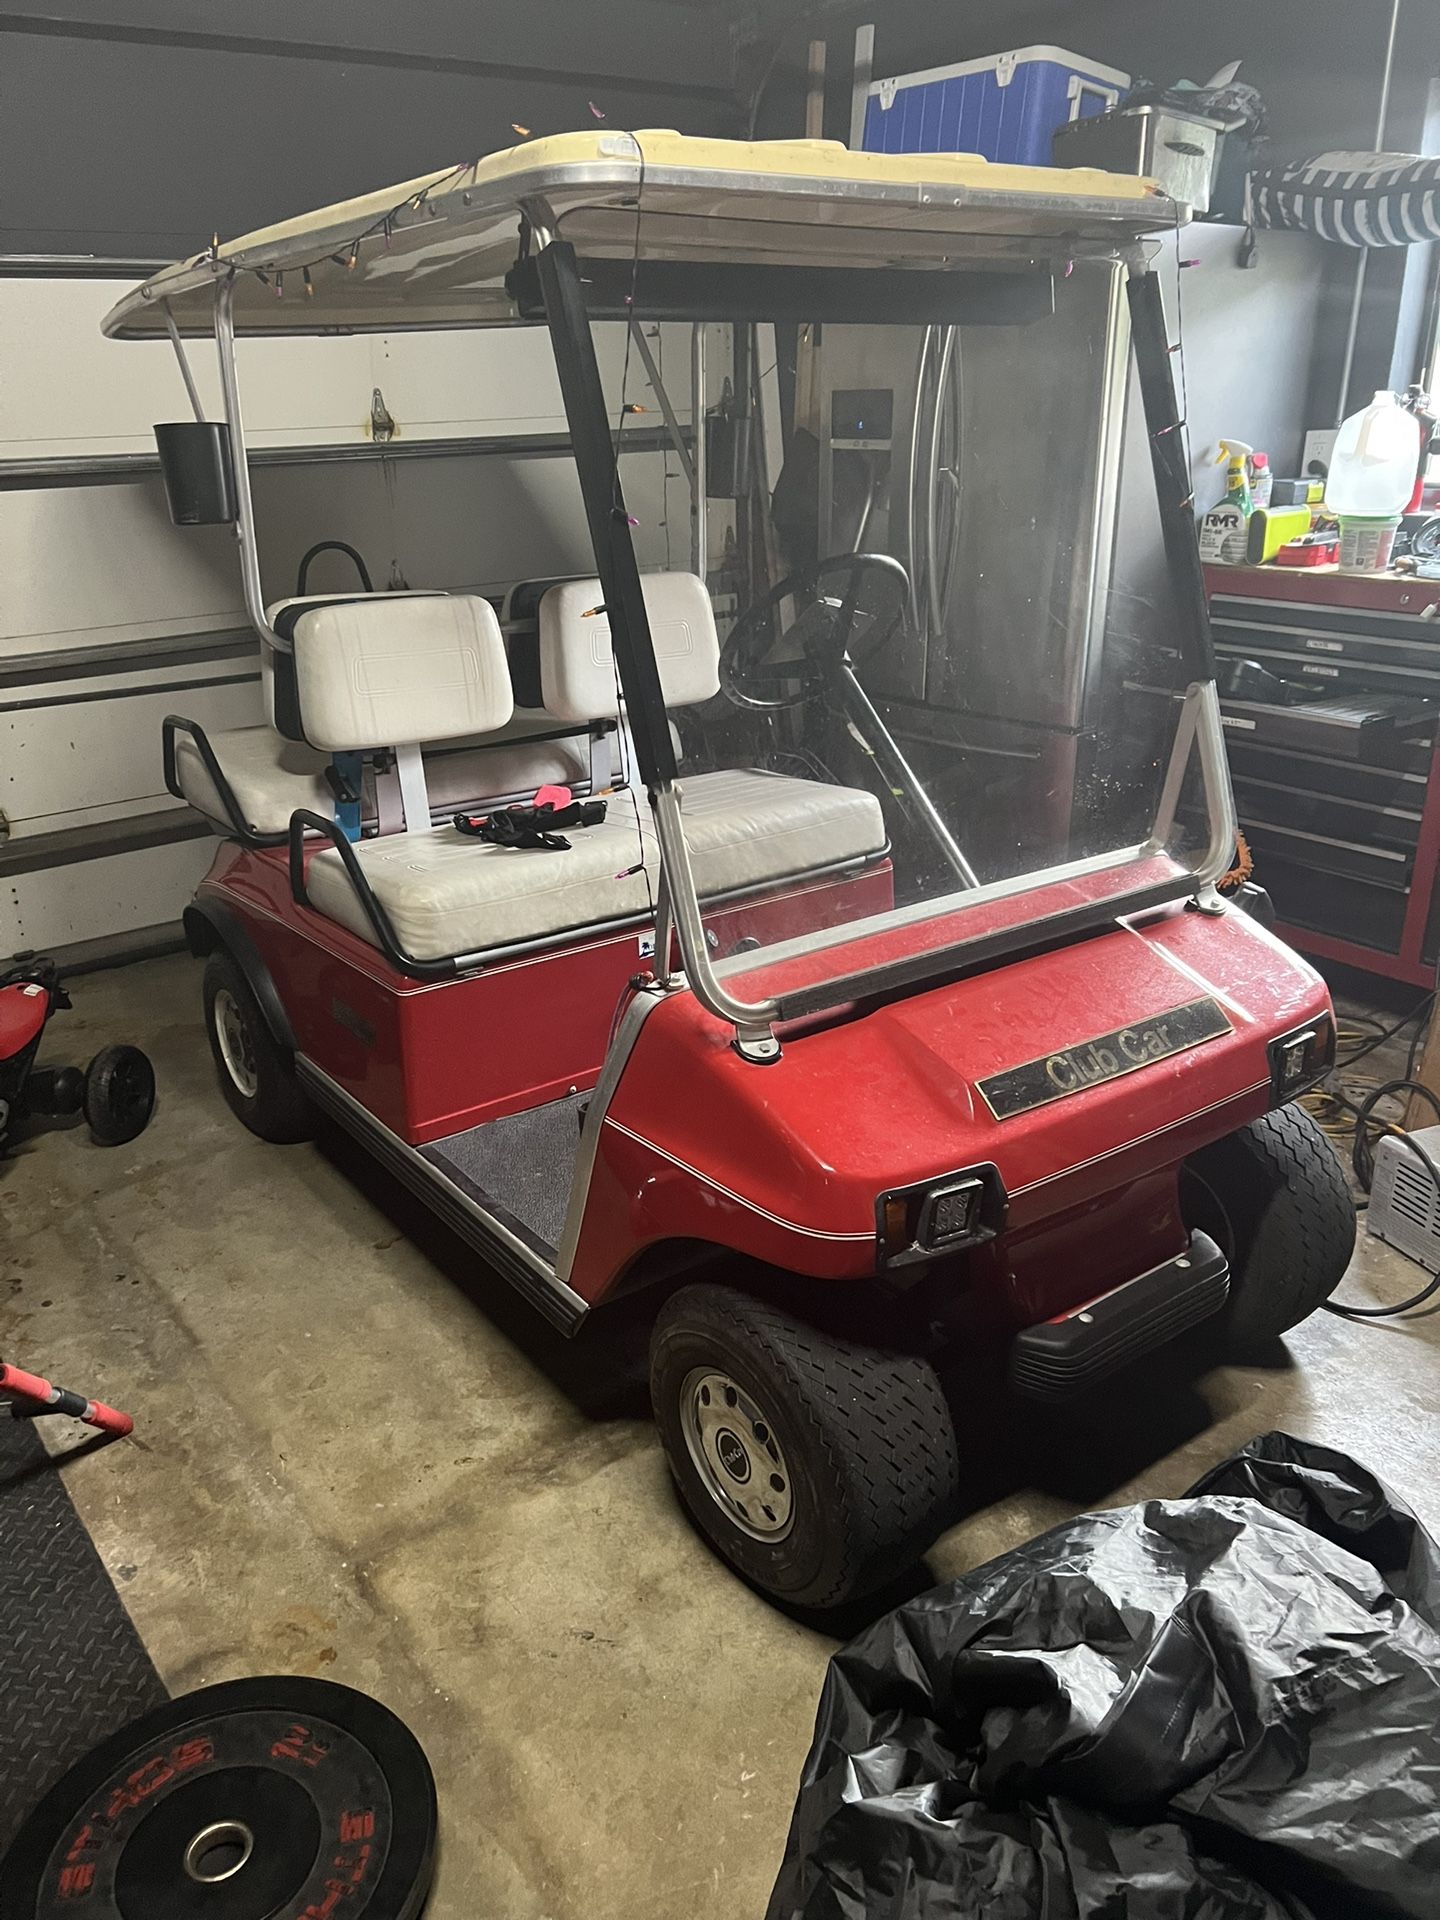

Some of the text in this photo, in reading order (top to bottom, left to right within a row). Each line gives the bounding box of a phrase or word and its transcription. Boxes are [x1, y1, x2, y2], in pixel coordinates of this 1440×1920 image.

[1205, 514, 1239, 528] RMR
[1046, 1022, 1173, 1090] Club Car
